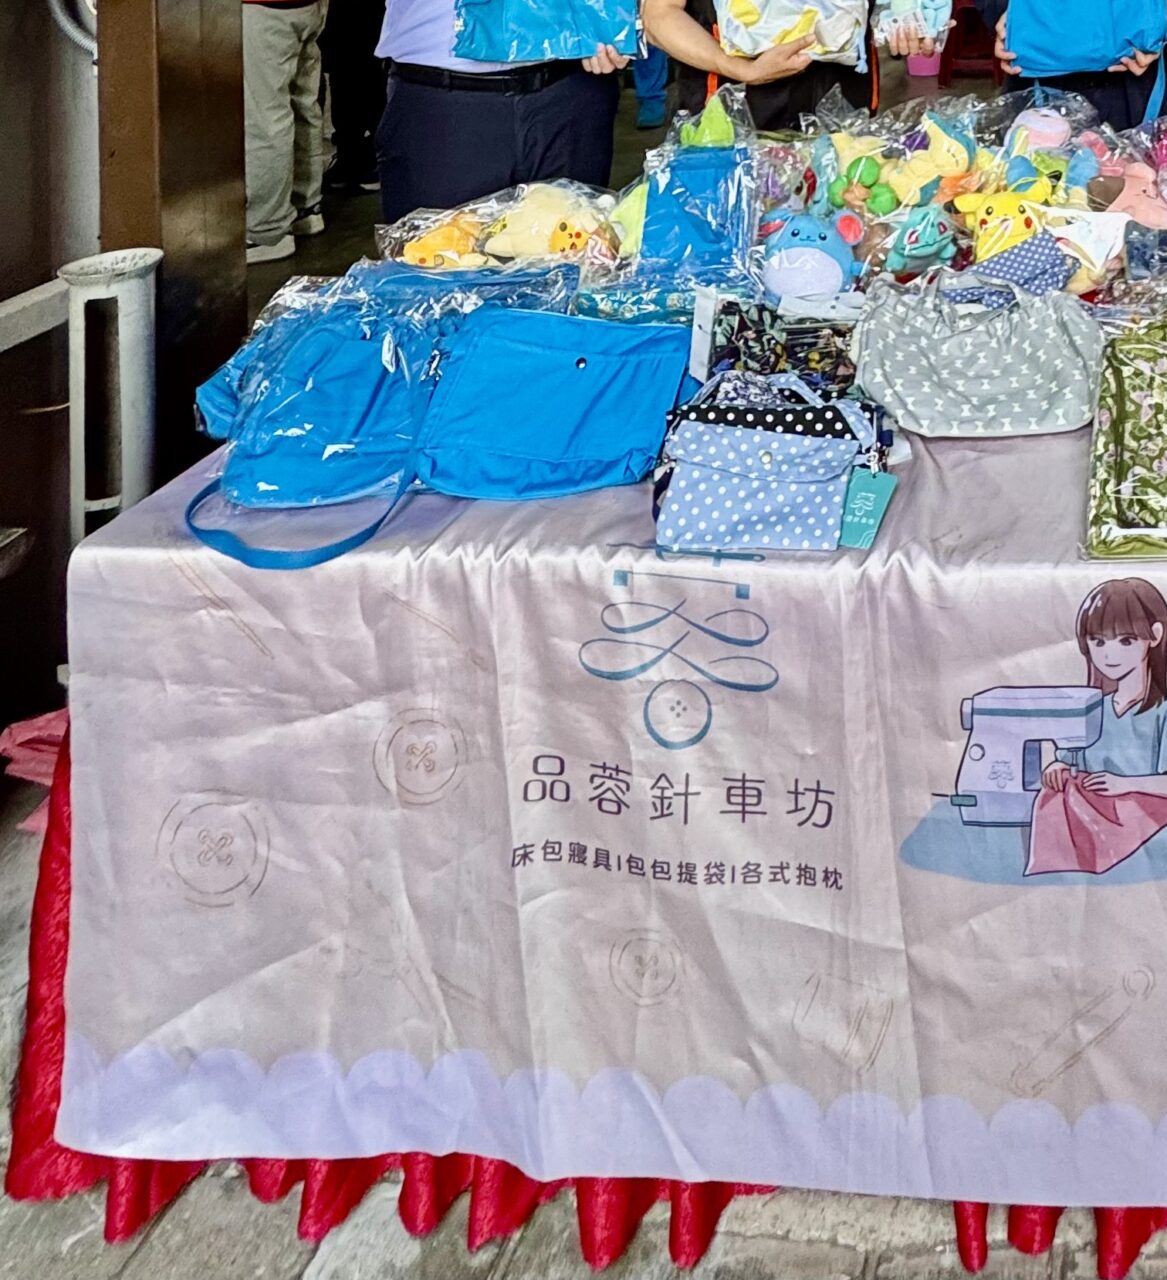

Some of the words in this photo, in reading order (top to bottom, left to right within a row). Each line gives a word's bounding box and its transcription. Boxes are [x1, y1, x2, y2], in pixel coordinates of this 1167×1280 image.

[523, 754, 836, 829] 品蓉針車坊
